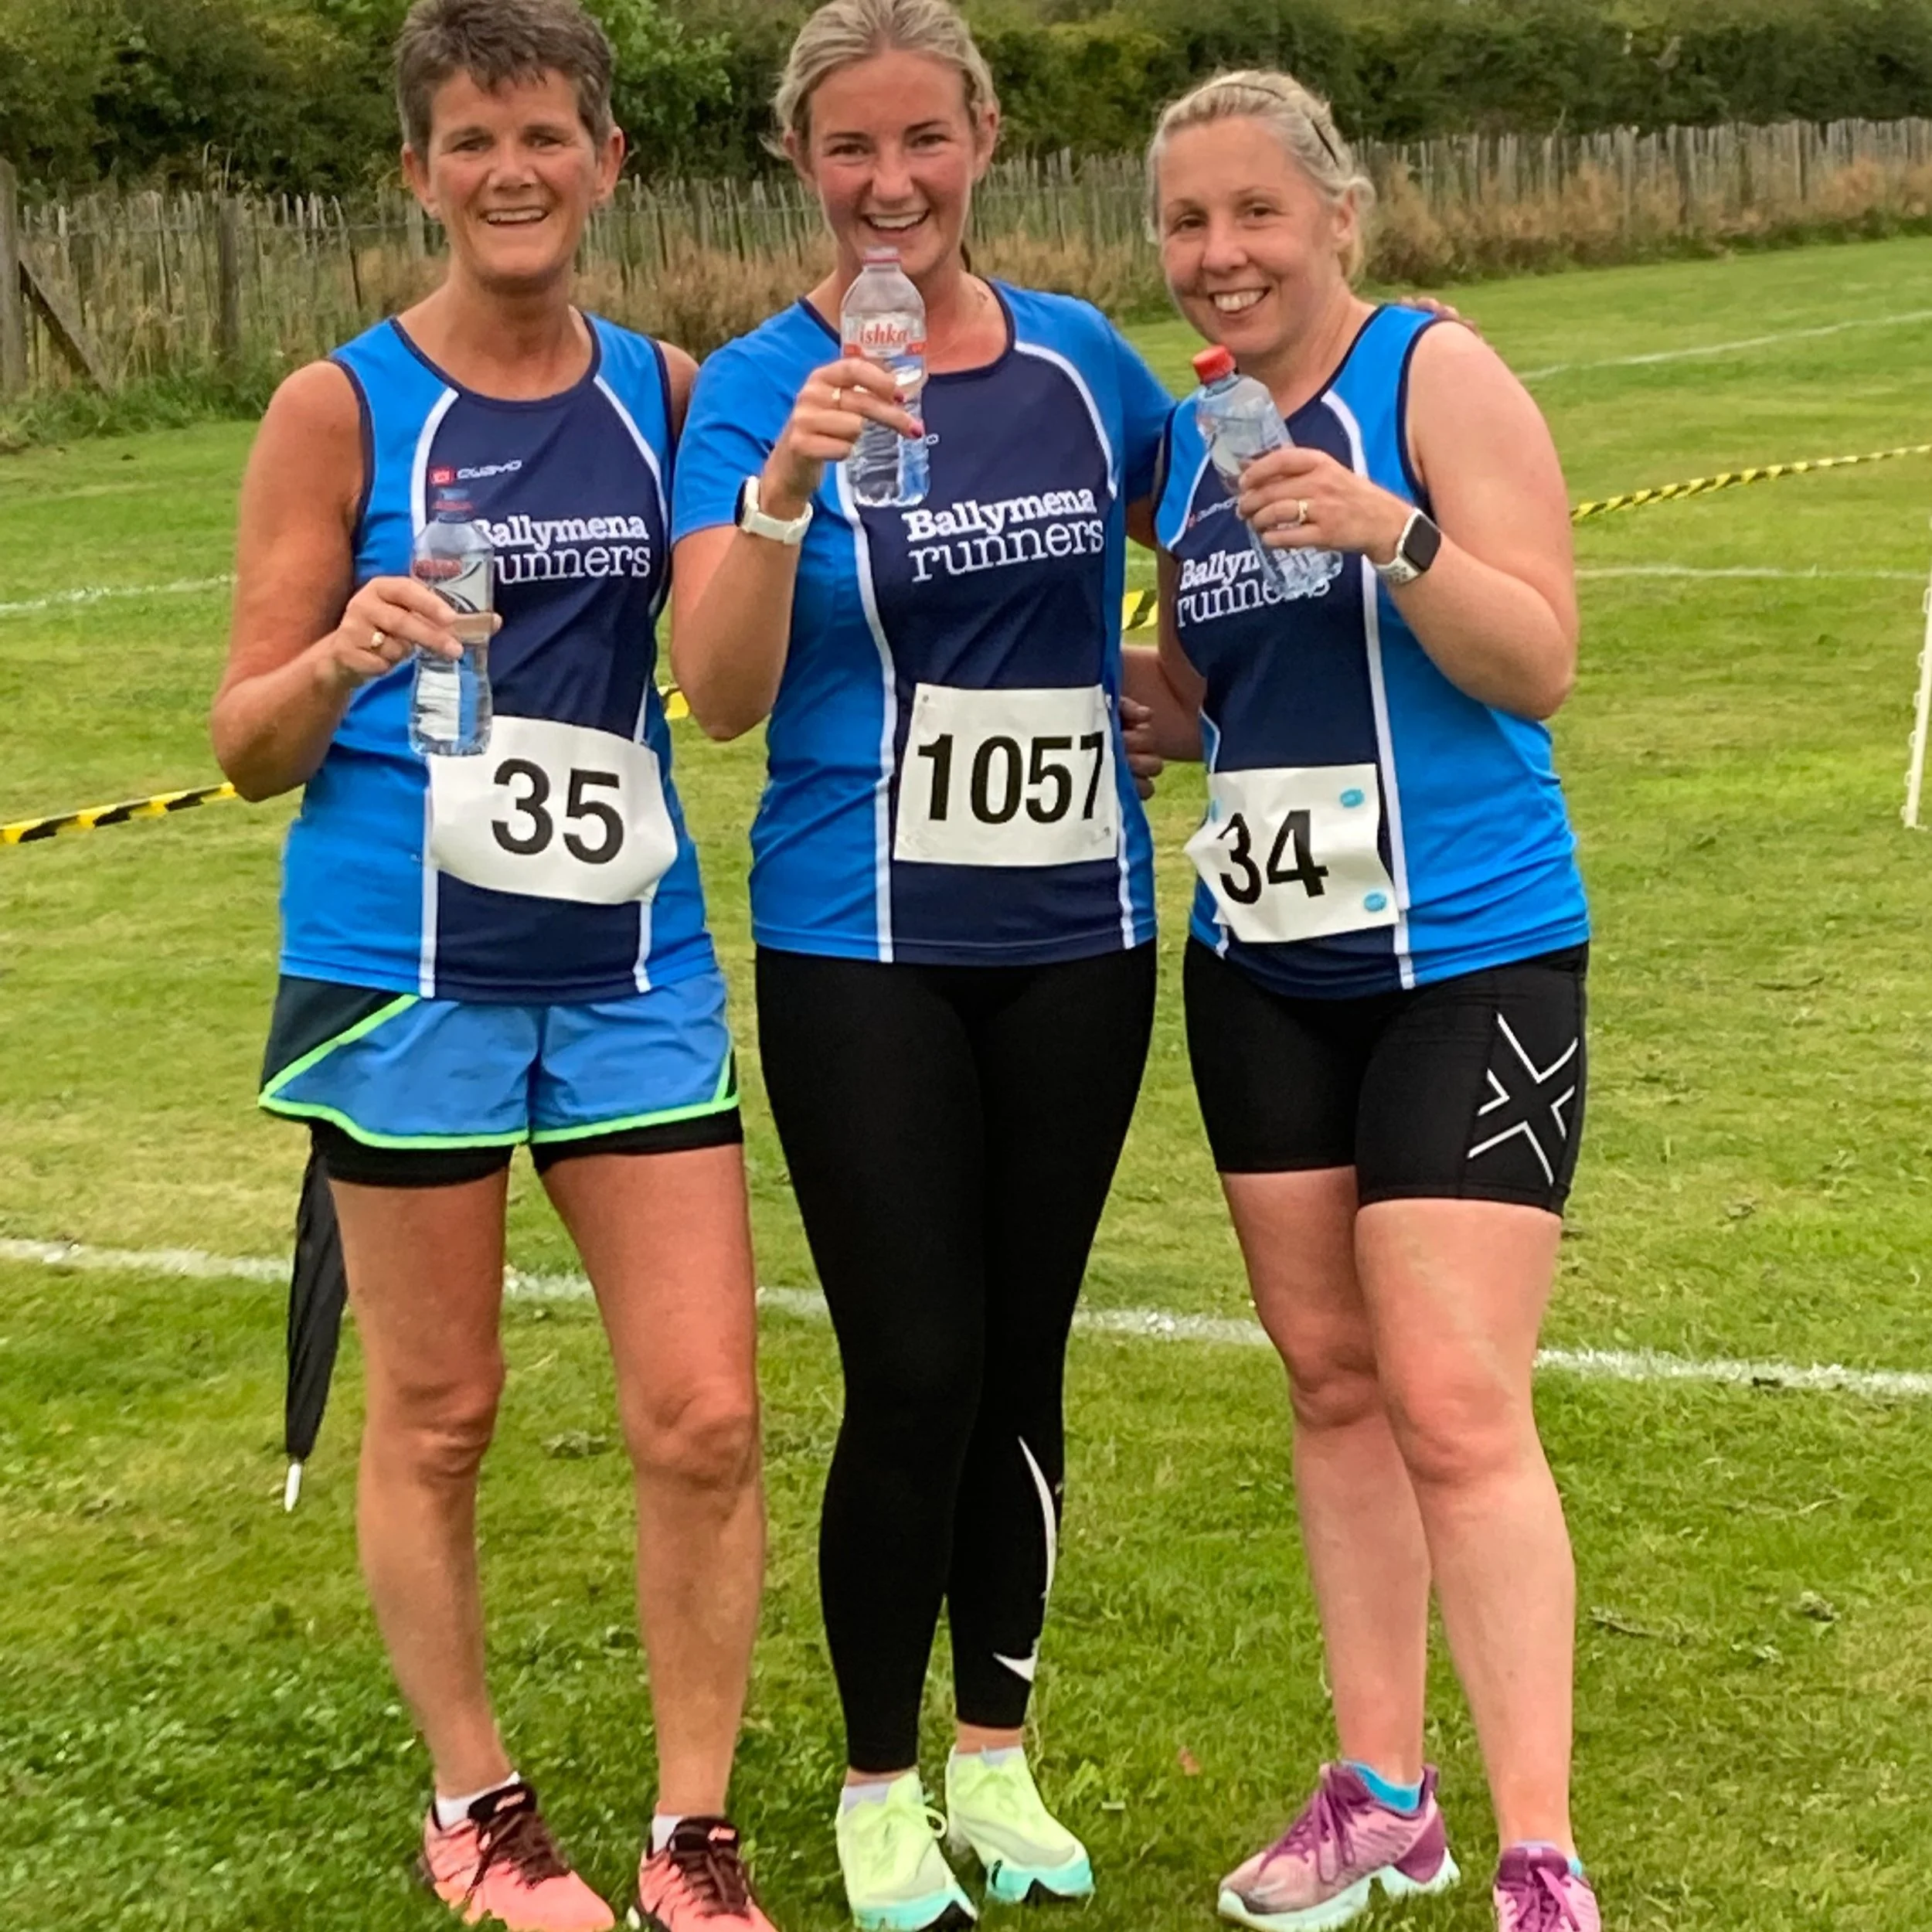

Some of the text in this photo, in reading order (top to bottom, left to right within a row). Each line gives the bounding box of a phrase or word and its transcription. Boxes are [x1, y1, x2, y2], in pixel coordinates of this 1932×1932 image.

[859, 322, 908, 345] ishka
[902, 488, 1097, 542] Ballymena
[493, 546, 651, 585] unners
[908, 519, 1104, 583] runners
[917, 730, 1105, 825] 1057
[491, 757, 624, 865] 35
[1216, 808, 1329, 905] 34
